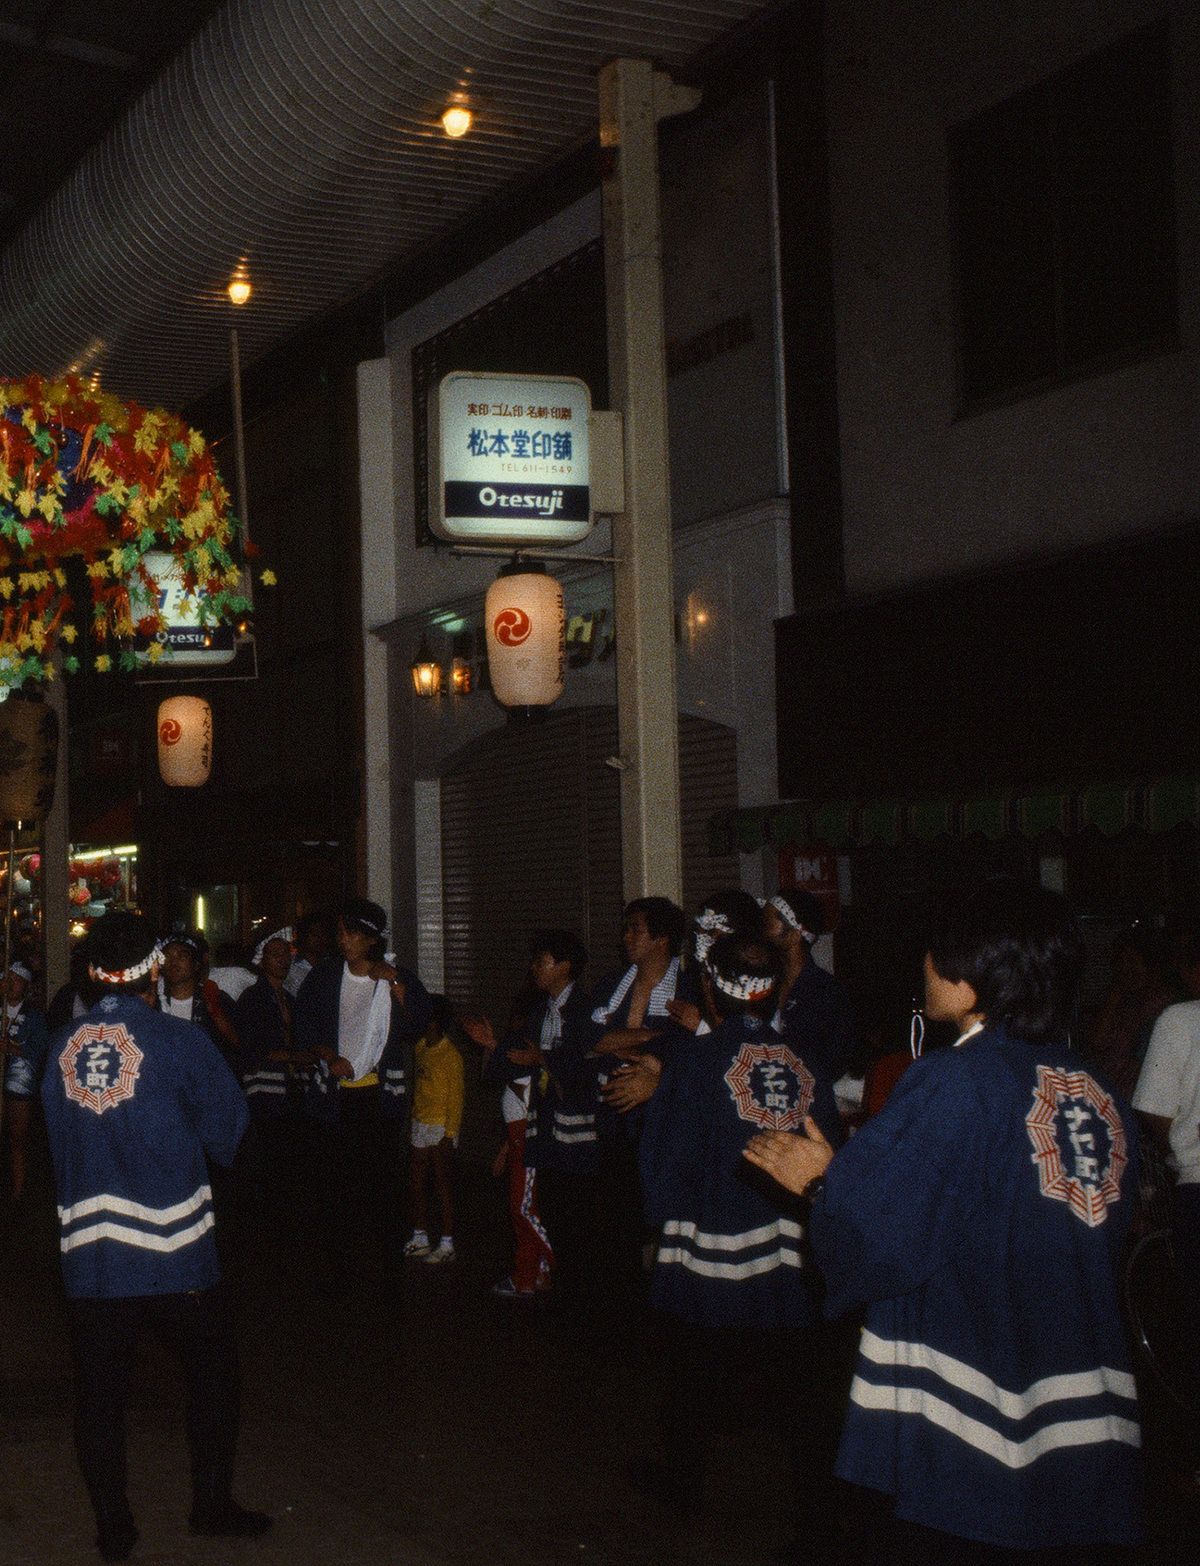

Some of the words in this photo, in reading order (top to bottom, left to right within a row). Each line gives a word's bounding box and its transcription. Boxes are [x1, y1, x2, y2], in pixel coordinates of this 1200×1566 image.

[500, 463, 519, 473] TEL
[522, 463, 572, 474] 611-1549
[479, 486, 564, 515] Otesuji
[86, 1044, 111, 1088] ナヤ町
[760, 1065, 790, 1110] ナヤ町
[1063, 1106, 1100, 1182] ナヤ町
